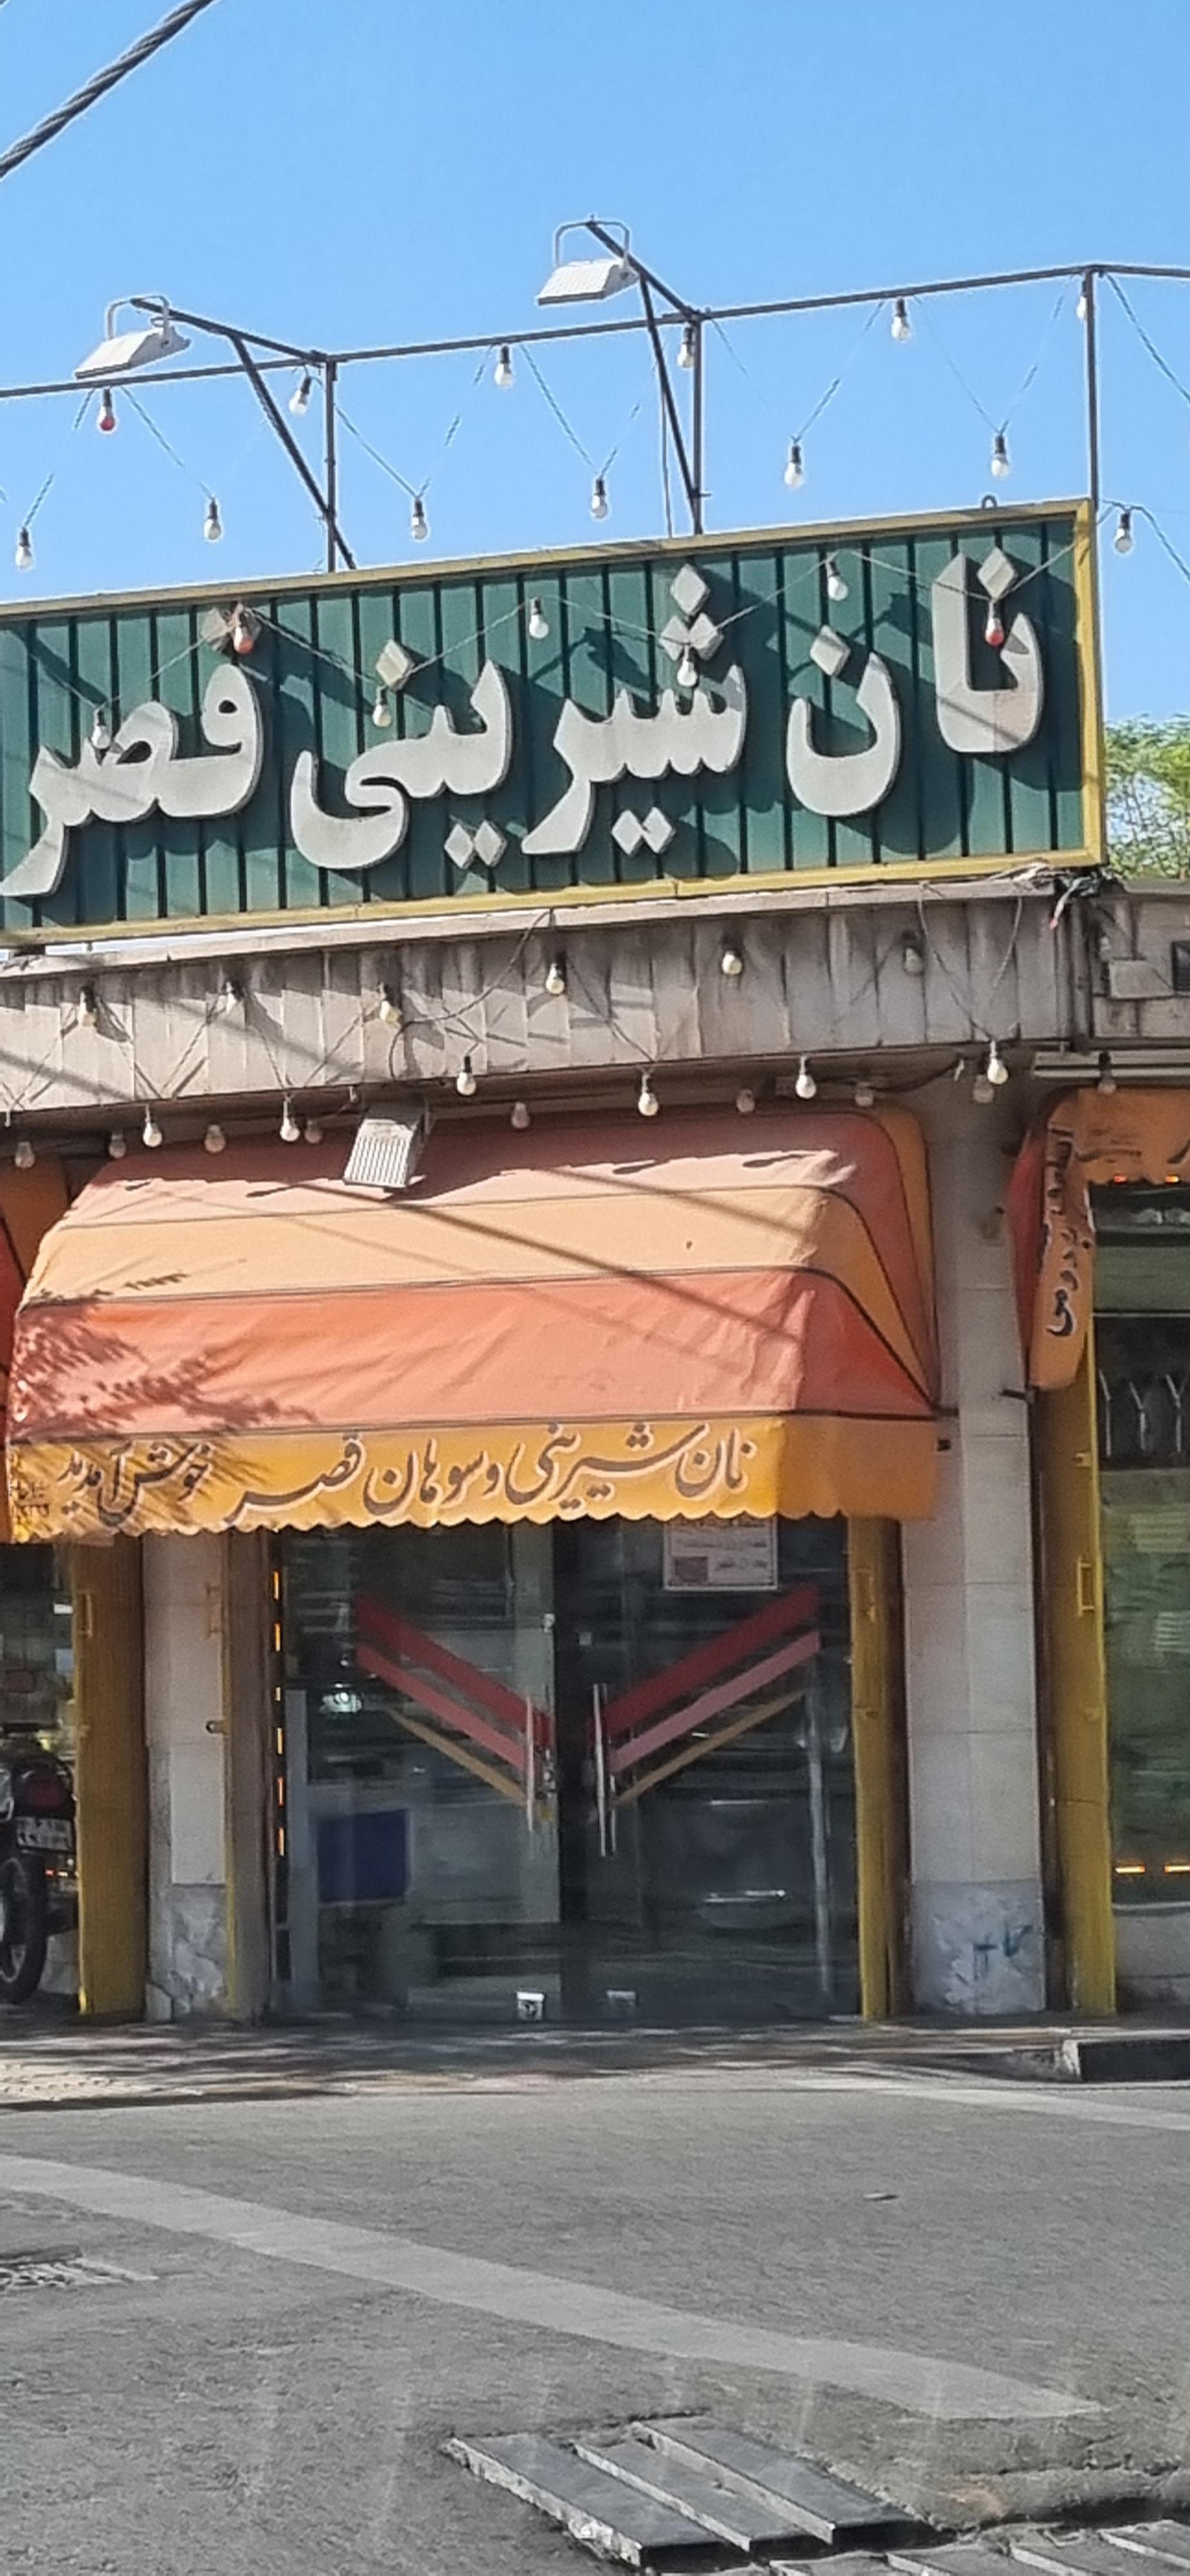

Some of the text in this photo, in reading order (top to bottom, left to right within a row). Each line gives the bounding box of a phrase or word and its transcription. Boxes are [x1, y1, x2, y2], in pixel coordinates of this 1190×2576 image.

[0, 546, 1044, 897] نان شیرینی قصر
[56, 1441, 134, 1516] آمدید
[98, 1441, 212, 1528] خوش
[222, 1432, 365, 1525] قصر
[505, 1421, 708, 1511] شیرینی
[674, 1426, 755, 1499] نان
